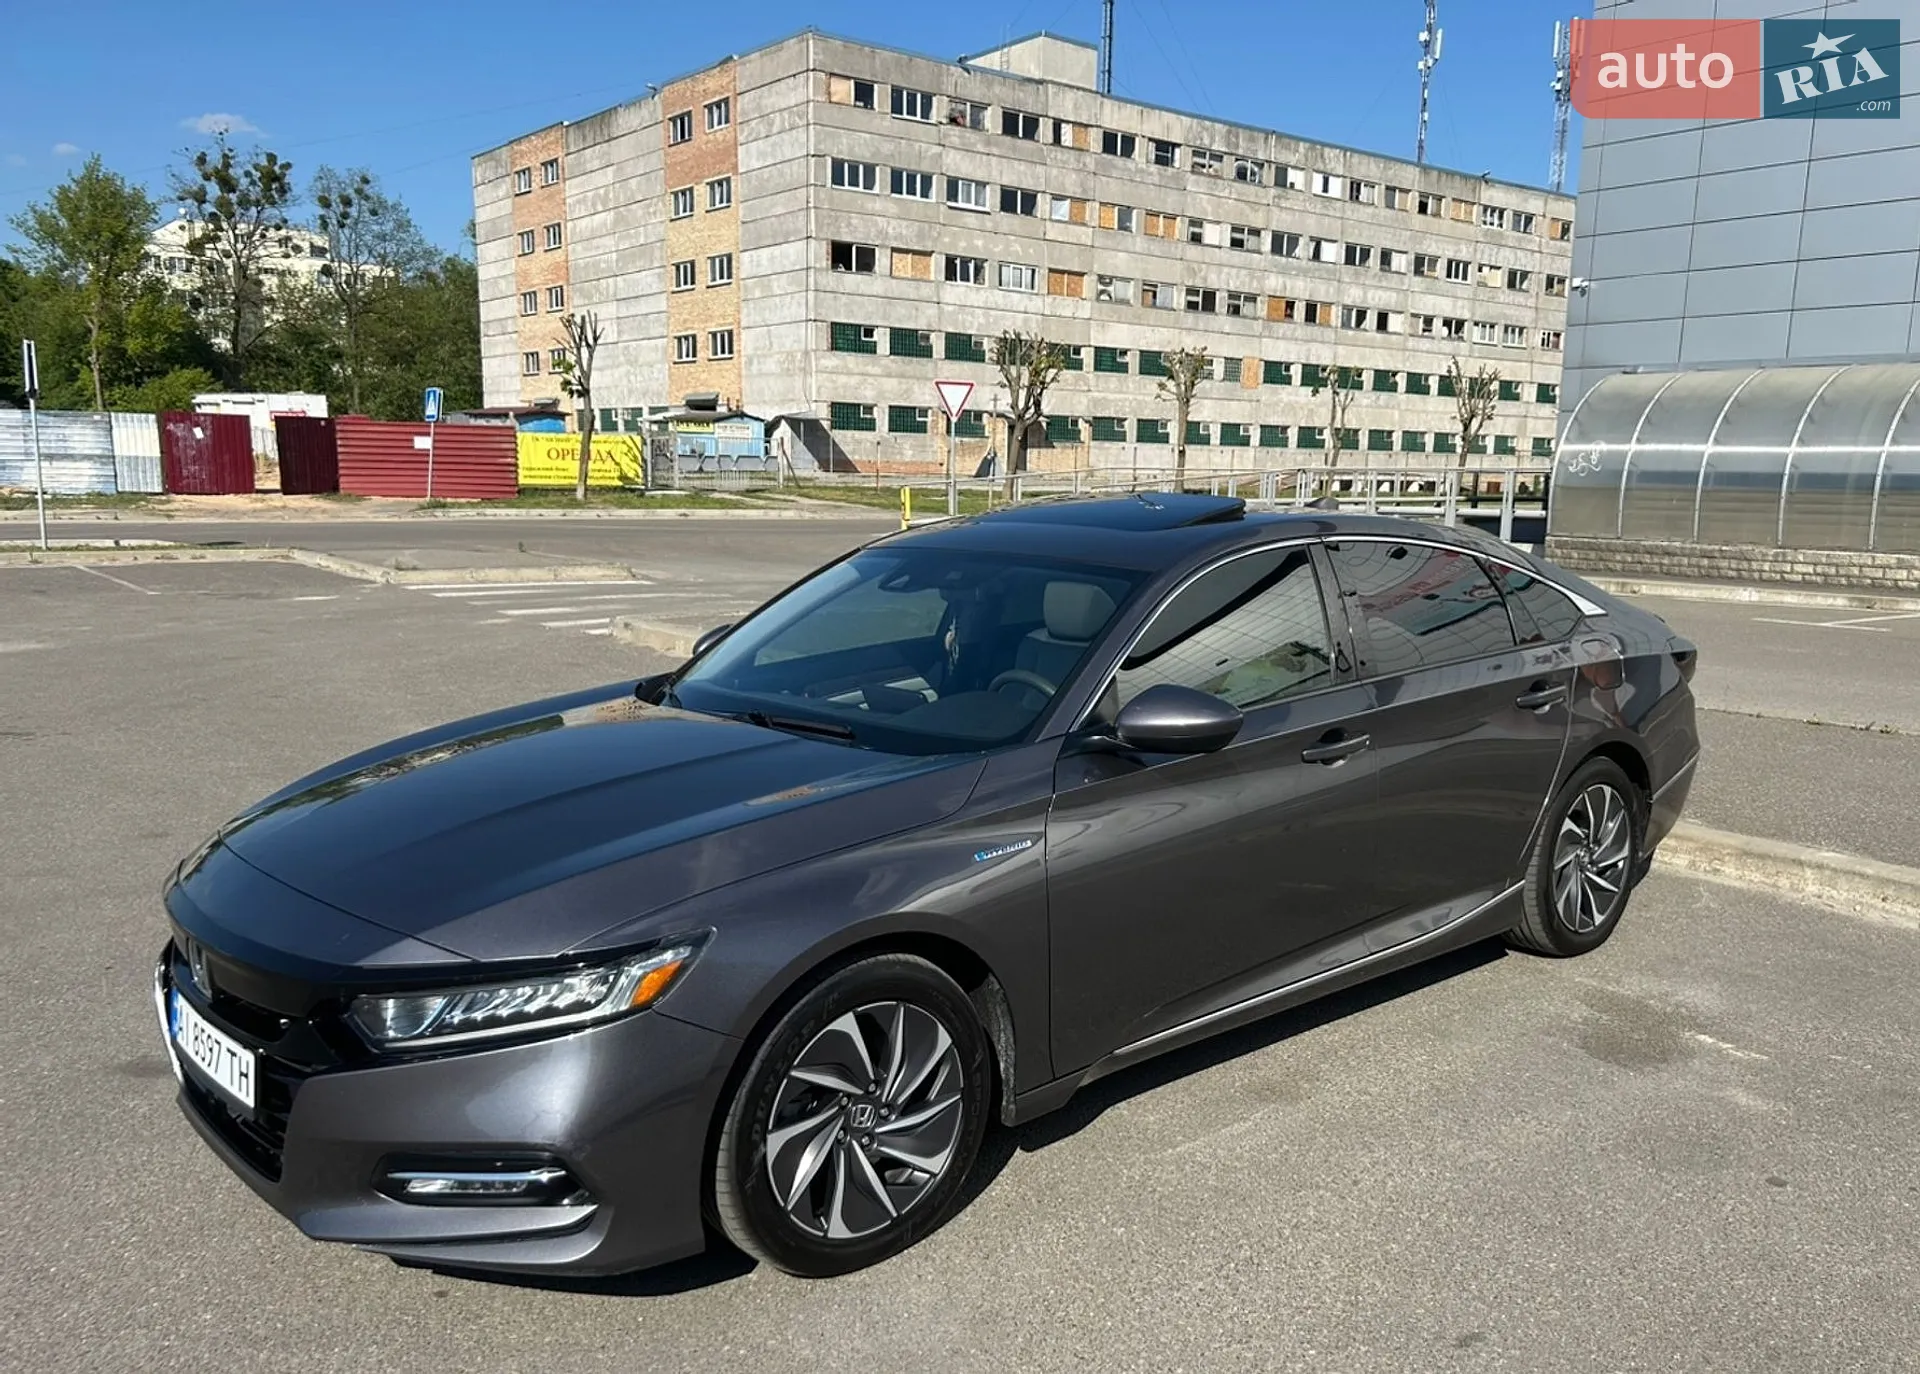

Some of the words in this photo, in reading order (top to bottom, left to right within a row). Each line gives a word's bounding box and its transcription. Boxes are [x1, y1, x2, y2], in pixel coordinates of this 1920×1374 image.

[546, 446, 617, 465] ОРЕДА
[192, 1021, 223, 1075] 8597
[226, 1046, 250, 1099] TH
